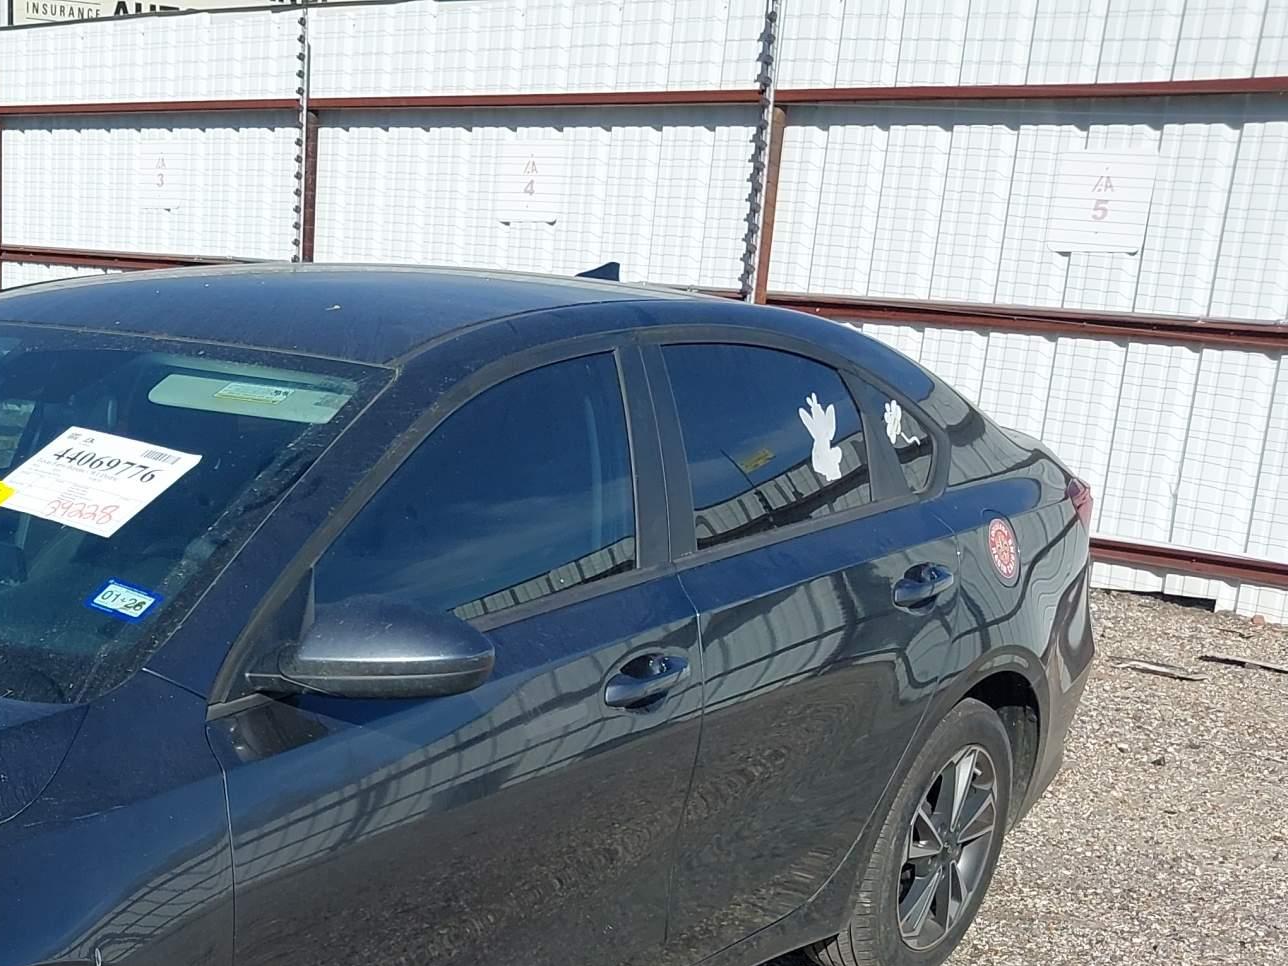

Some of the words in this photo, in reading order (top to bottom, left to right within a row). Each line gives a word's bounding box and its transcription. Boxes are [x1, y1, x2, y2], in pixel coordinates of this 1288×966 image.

[26, 1, 100, 19] INSURANCE
[156, 173, 165, 188] 3
[524, 179, 535, 195] 4
[1091, 199, 1109, 221] 5
[53, 447, 160, 484] 44069776
